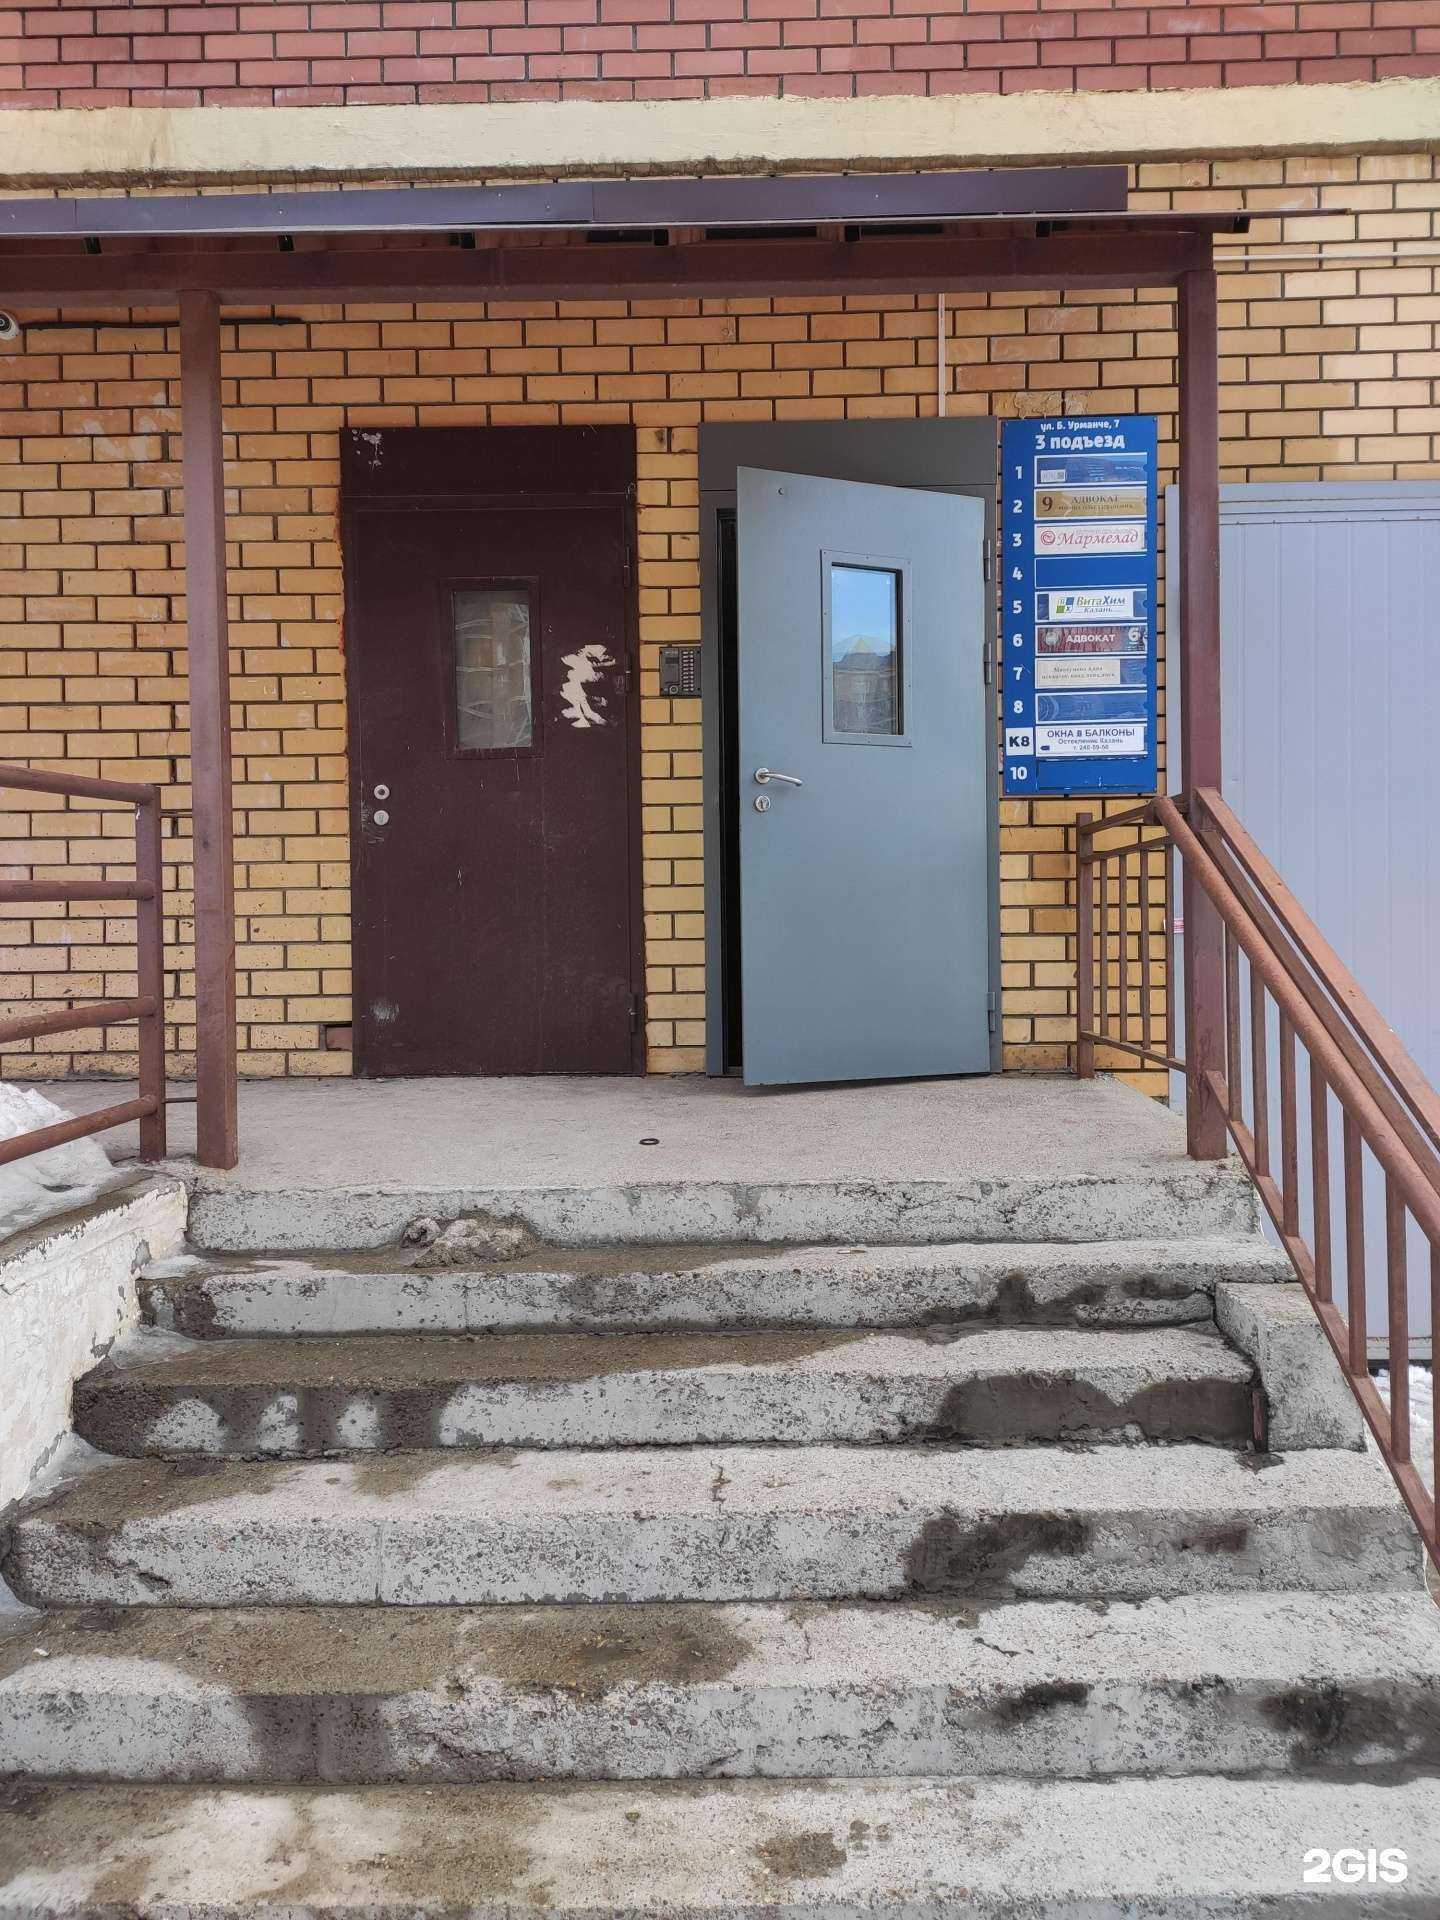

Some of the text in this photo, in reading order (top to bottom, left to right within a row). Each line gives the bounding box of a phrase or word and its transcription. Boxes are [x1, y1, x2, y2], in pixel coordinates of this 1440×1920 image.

[1040, 418, 1120, 432] ул. Б. Урманче, 7
[1035, 434, 1126, 450] 3 подъезд
[1015, 466, 1023, 479] 1
[1012, 499, 1023, 513] 2
[1042, 496, 1053, 512] 9
[1012, 533, 1022, 547] 3
[1057, 528, 1139, 548] Мармелад
[1012, 567, 1023, 580] 4
[1013, 600, 1023, 614] 5
[1076, 595, 1126, 607] ВитаХим
[1012, 633, 1023, 647] 6
[1066, 634, 1116, 643] АДВОКАТ
[1128, 626, 1140, 642] 6
[1013, 667, 1023, 681] 7
[1013, 700, 1024, 714] 8
[1047, 729, 1074, 738] ОКНА
[1085, 728, 1135, 737] БАЛКОНЫ
[1009, 735, 1030, 747] К8
[1009, 766, 1028, 780] 10
